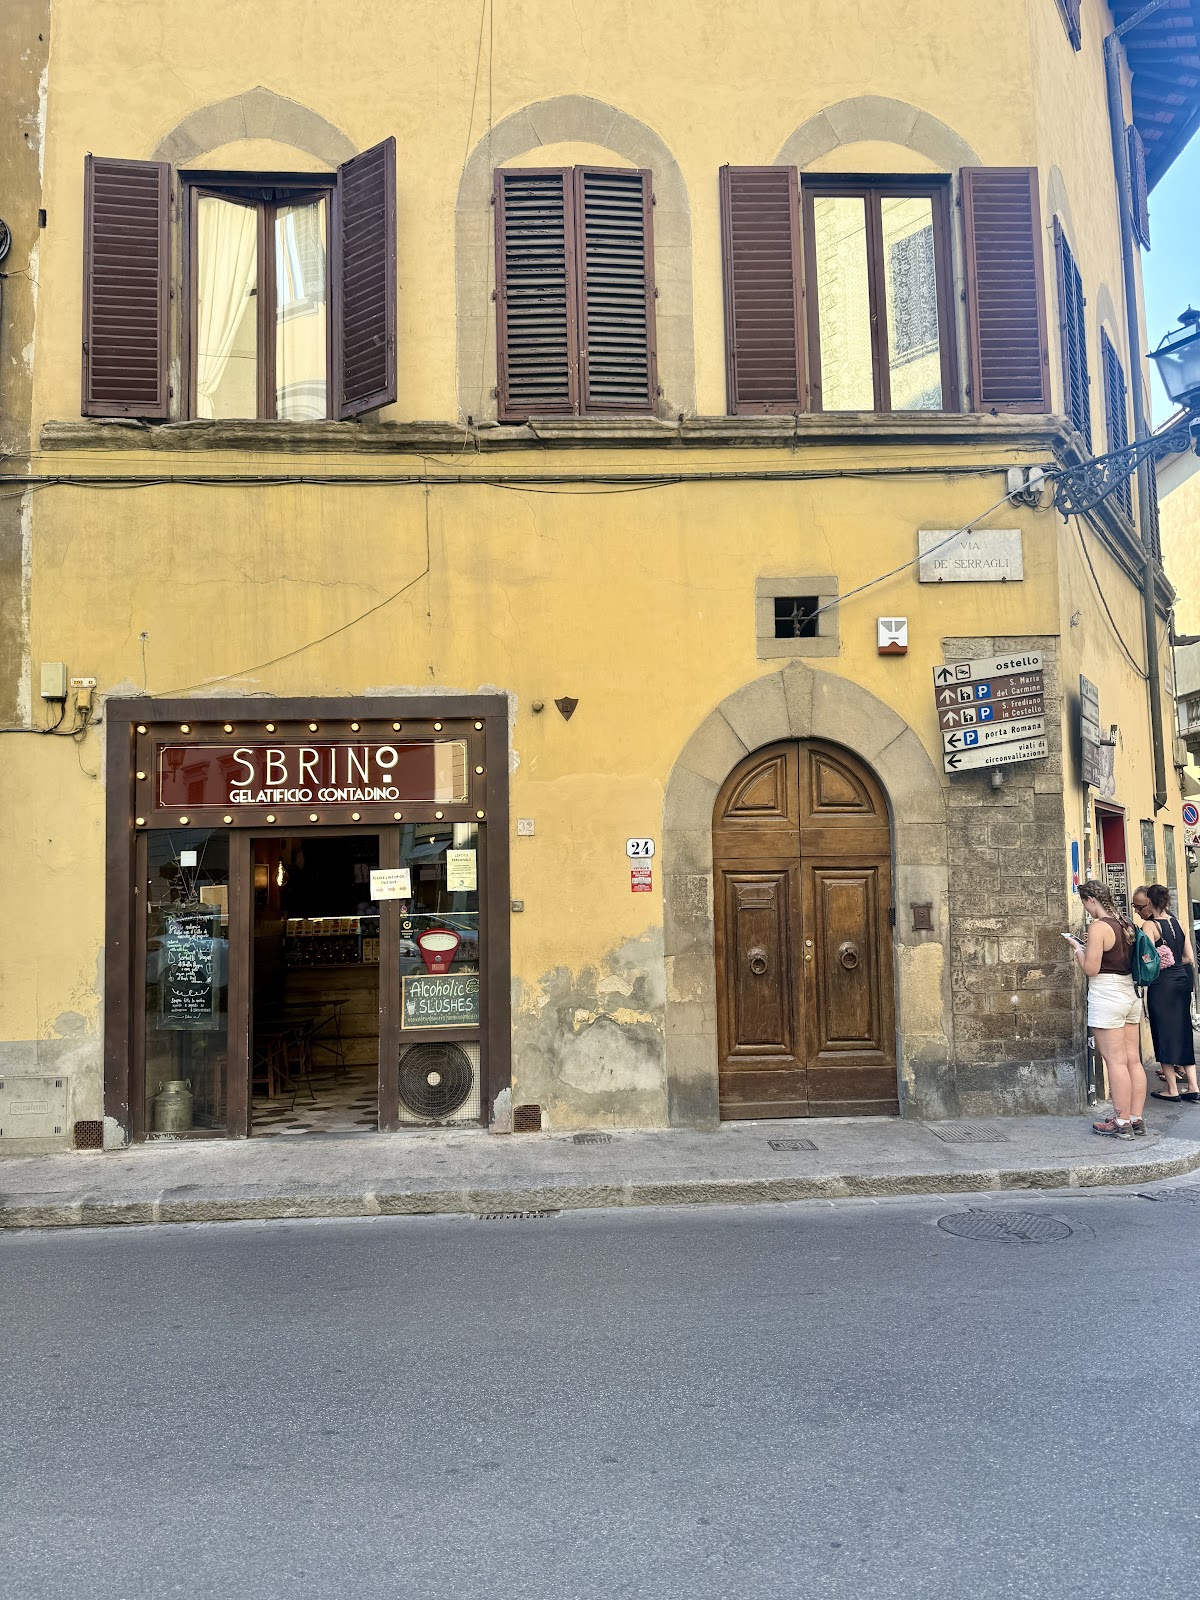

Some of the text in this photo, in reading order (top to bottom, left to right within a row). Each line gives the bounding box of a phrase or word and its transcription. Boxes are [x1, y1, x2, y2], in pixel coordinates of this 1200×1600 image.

[960, 542, 980, 550] VIA
[954, 558, 1009, 569] SERRAGLI
[996, 657, 1039, 670] ostello
[978, 675, 1040, 698] P S. Maria
[996, 685, 1041, 697] del Carmine
[980, 697, 1041, 720] P S. Frediano
[1012, 706, 1042, 717] Cestello
[966, 723, 1042, 744] P porta Romana
[1018, 742, 1036, 751] viali
[985, 750, 1045, 764] circonvallazione
[229, 787, 400, 803] GELATIFICIO CONTADINO
[631, 841, 651, 856] 24
[410, 979, 465, 997] Alcoholic
[419, 998, 474, 1013] SLUSHES
